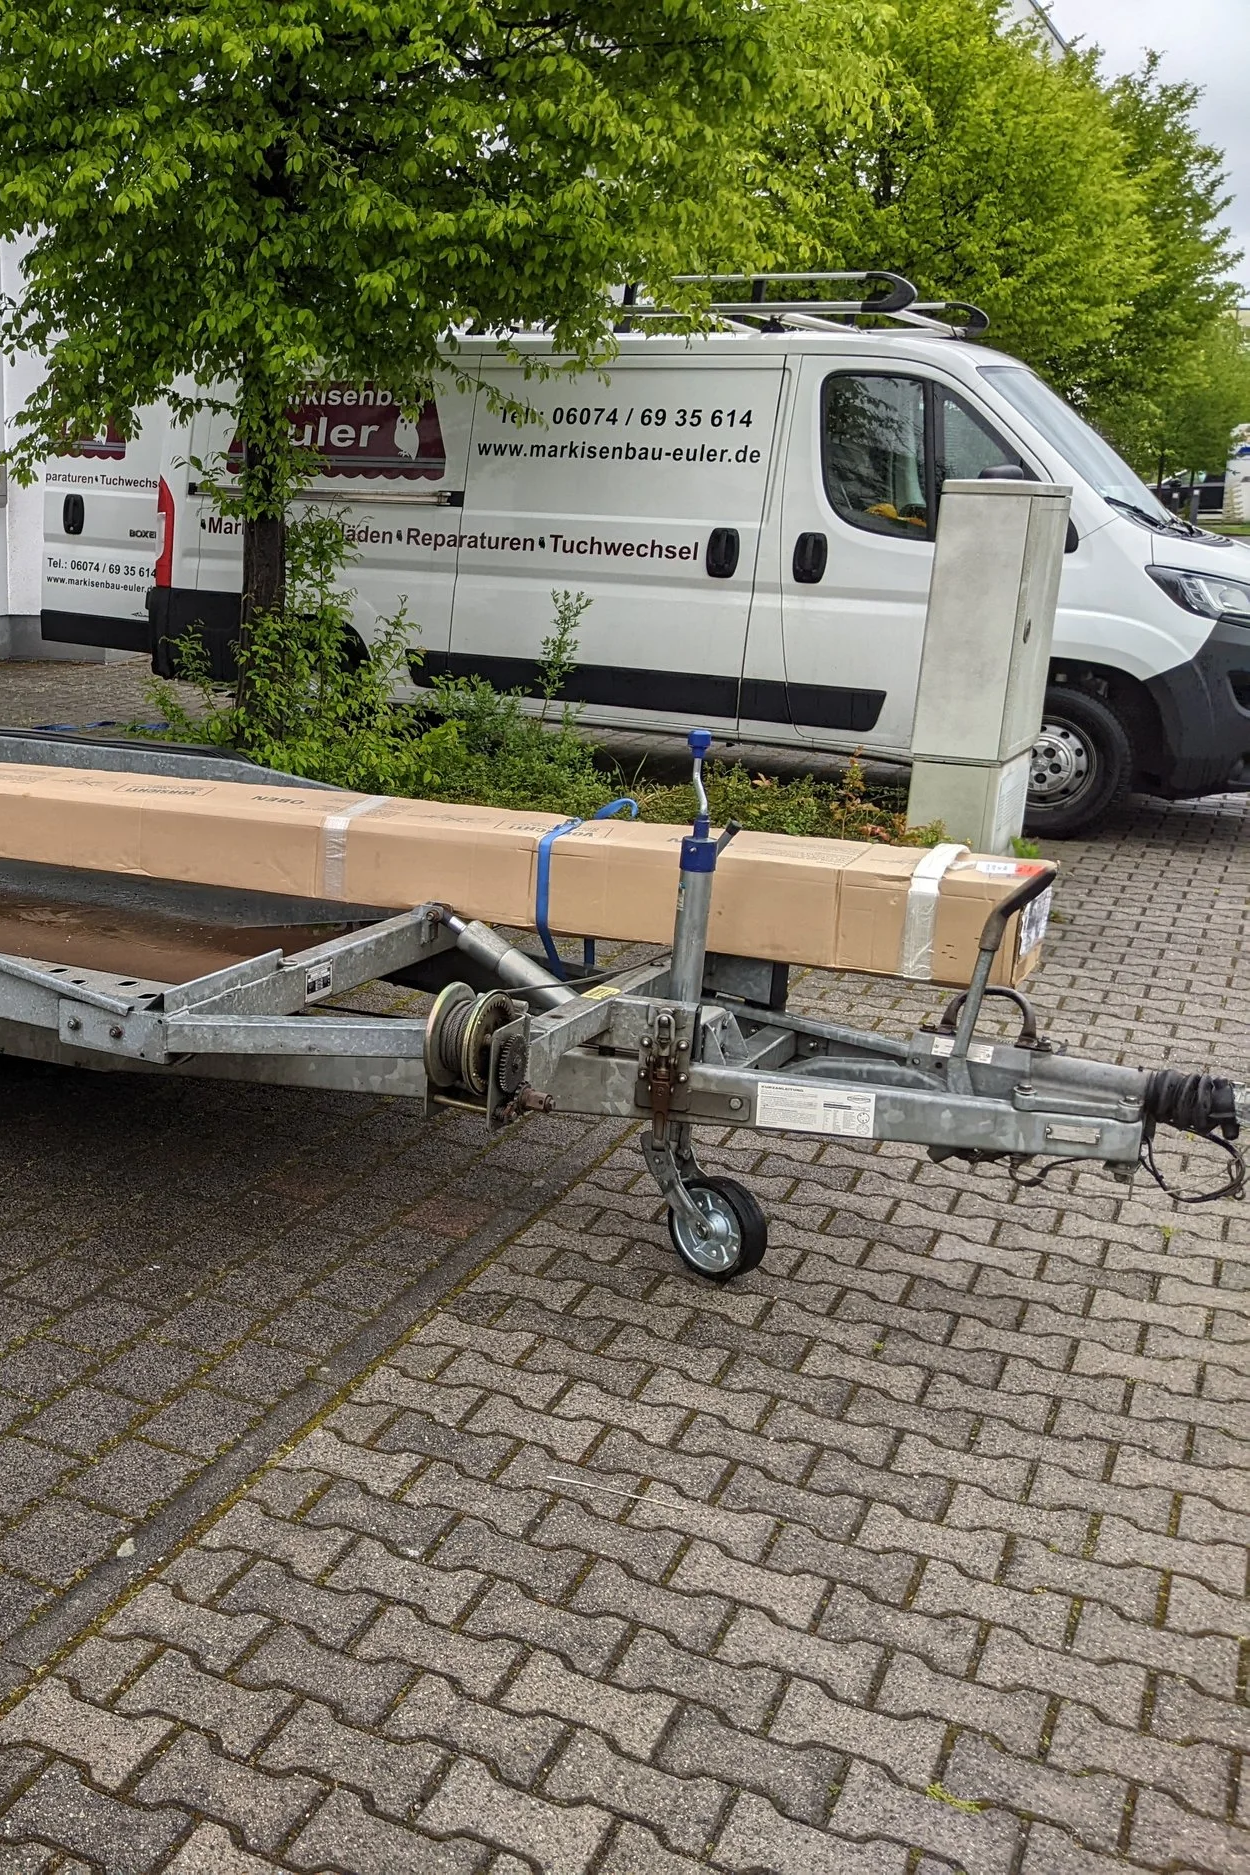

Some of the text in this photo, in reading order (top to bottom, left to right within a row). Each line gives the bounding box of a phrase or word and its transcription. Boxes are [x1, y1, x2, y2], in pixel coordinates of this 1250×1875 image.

[552, 406, 619, 426] 06074
[624, 407, 635, 427] /
[640, 407, 668, 427] 69
[674, 408, 703, 428] 35
[710, 408, 753, 429] 614
[288, 416, 381, 448] uler
[477, 440, 761, 464] www.markisenbau-euler.de
[45, 472, 94, 485] paraturen
[129, 529, 157, 539] BOXE
[405, 527, 535, 552] Reparaturen
[549, 534, 699, 561] Tuchwechsel
[47, 557, 68, 570] Tel.:
[70, 559, 100, 573] 06074
[101, 562, 107, 574] /
[108, 563, 121, 575] 69
[123, 565, 136, 576] 35
[46, 575, 155, 593] www.markisenbau-euler.d
[251, 795, 305, 805] OBEN
